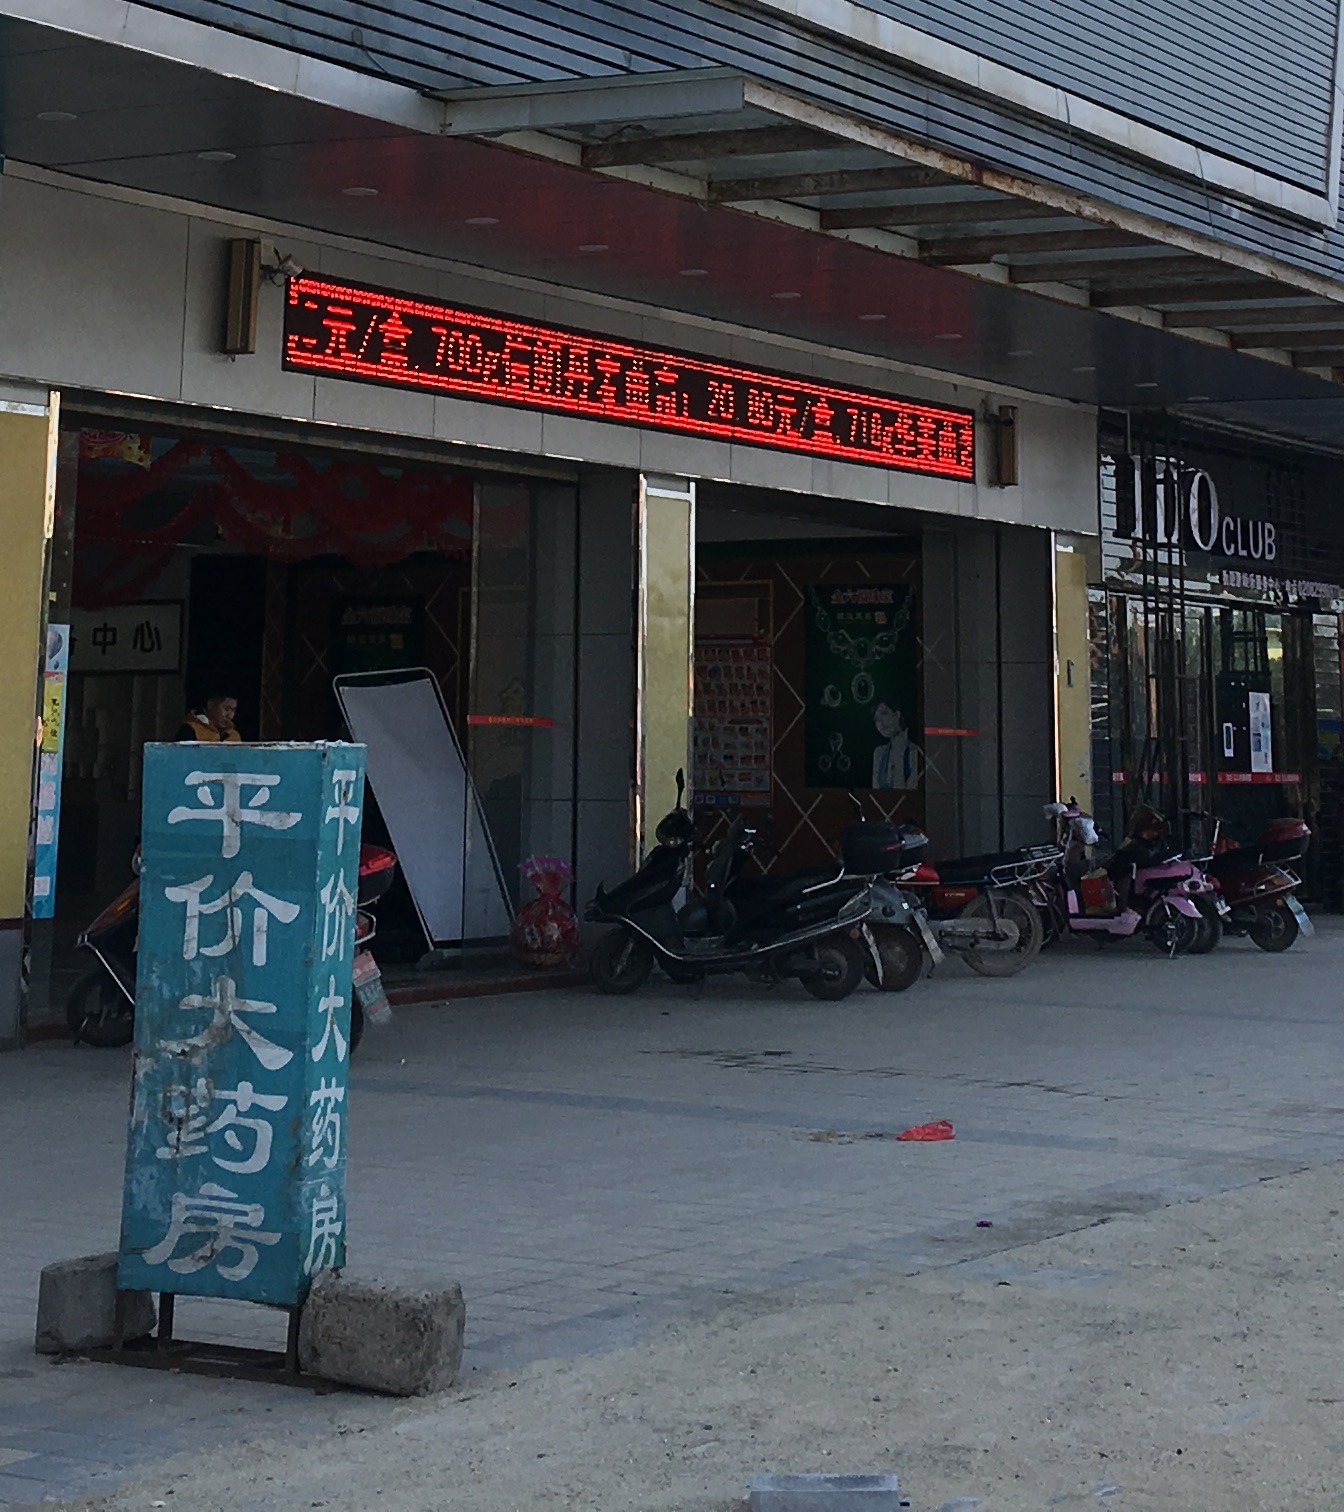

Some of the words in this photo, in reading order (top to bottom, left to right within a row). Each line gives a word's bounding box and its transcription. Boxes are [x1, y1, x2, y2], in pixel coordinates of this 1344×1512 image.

[1222, 516, 1277, 561] CLUB
[142, 770, 303, 1281] 平价大药房
[302, 768, 360, 1278] 平价大药房
